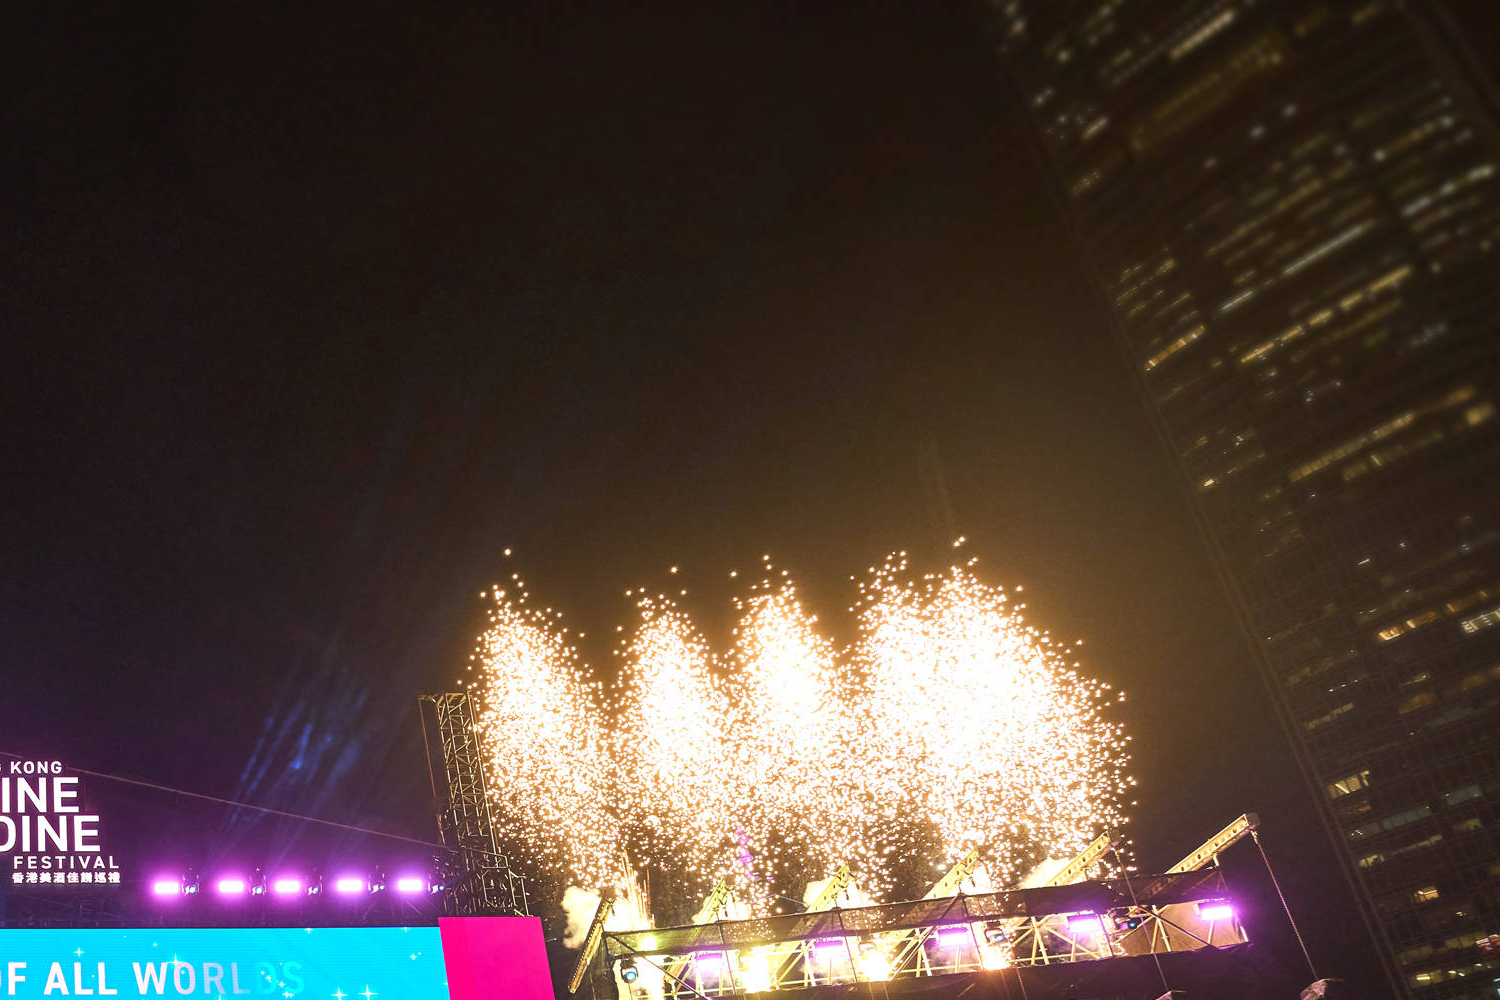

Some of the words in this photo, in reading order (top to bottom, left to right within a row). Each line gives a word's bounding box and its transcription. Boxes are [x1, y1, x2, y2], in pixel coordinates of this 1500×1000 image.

[10, 760, 63, 775] KONG
[13, 855, 120, 870] FESTIVAL
[43, 961, 118, 996] ALL
[132, 960, 306, 996] WORLDS
